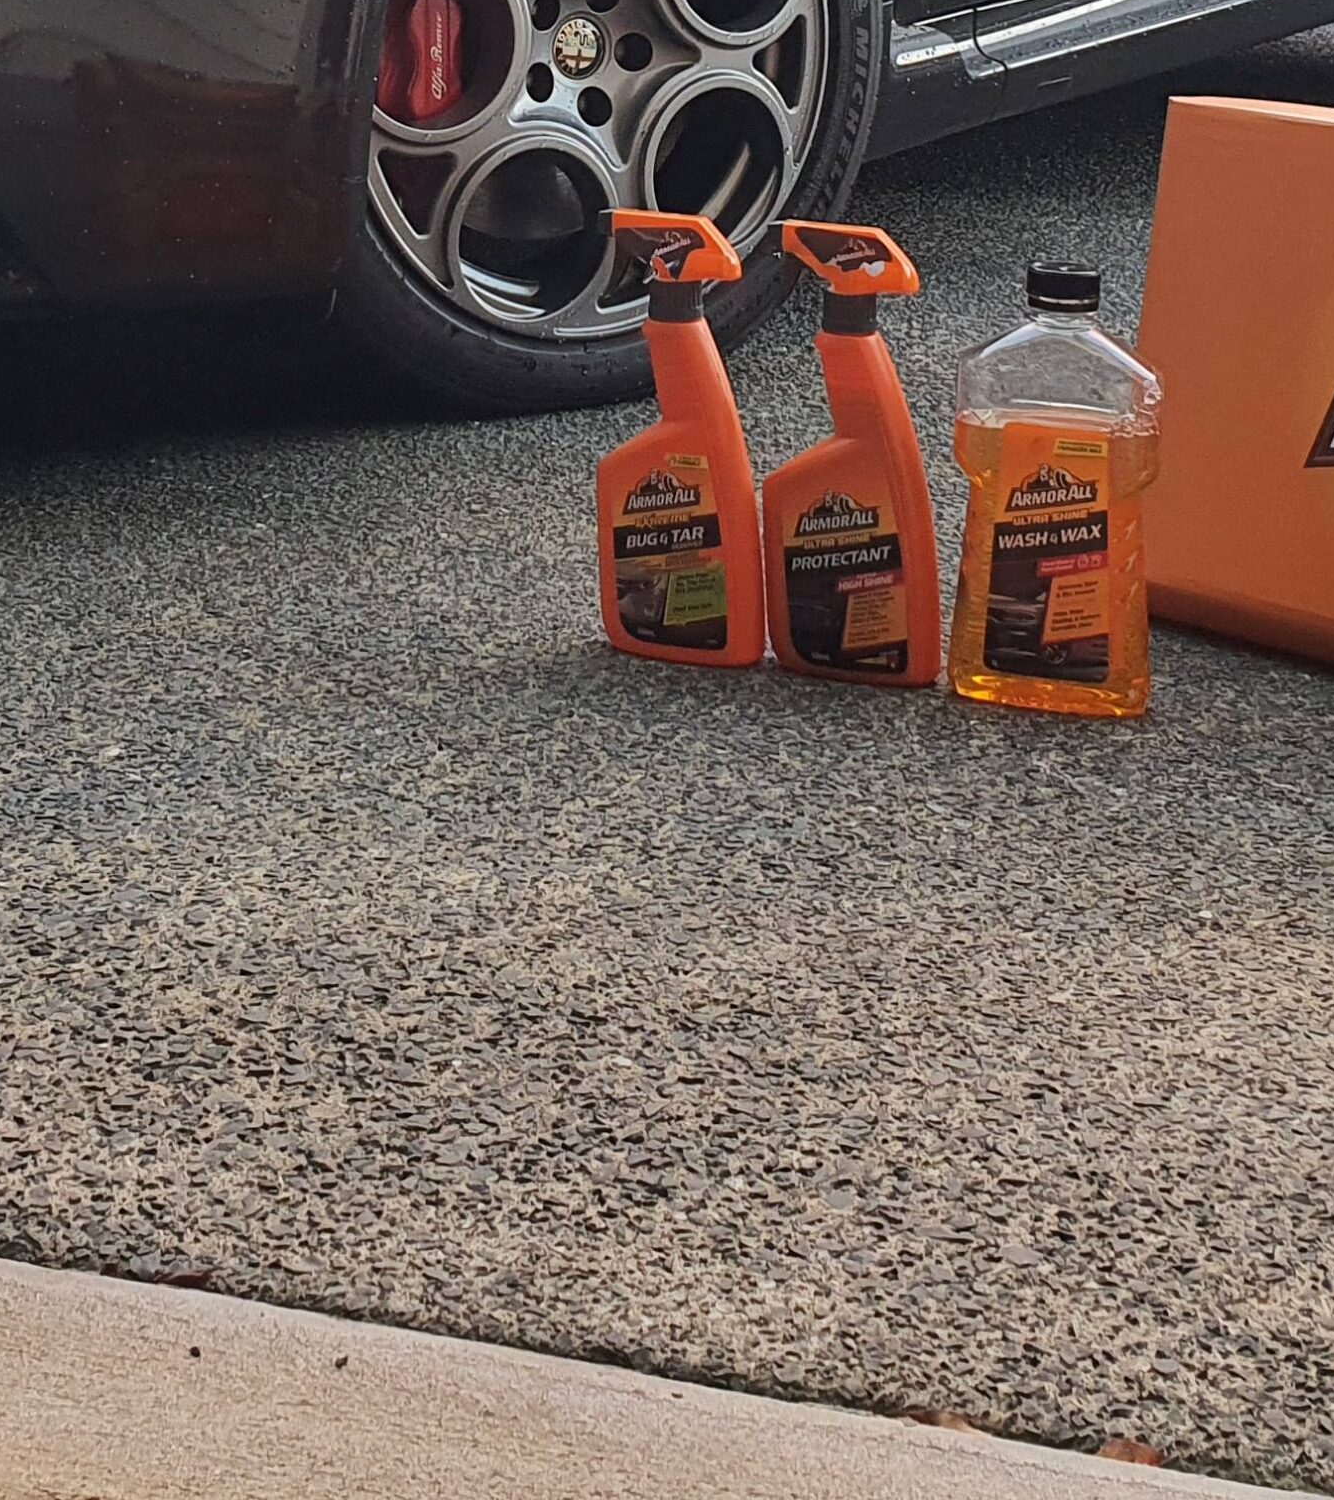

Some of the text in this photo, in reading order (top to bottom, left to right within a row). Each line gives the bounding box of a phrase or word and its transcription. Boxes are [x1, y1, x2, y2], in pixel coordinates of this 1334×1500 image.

[1013, 509, 1088, 526] ULTRA SHINE
[626, 532, 658, 549] BUG
[671, 526, 704, 543] TAR
[998, 531, 1049, 549] WASH
[1060, 523, 1103, 544] WAX
[791, 545, 892, 571] PROTECTANT
[838, 579, 863, 591] HIGH
[864, 574, 894, 588] SHINE
